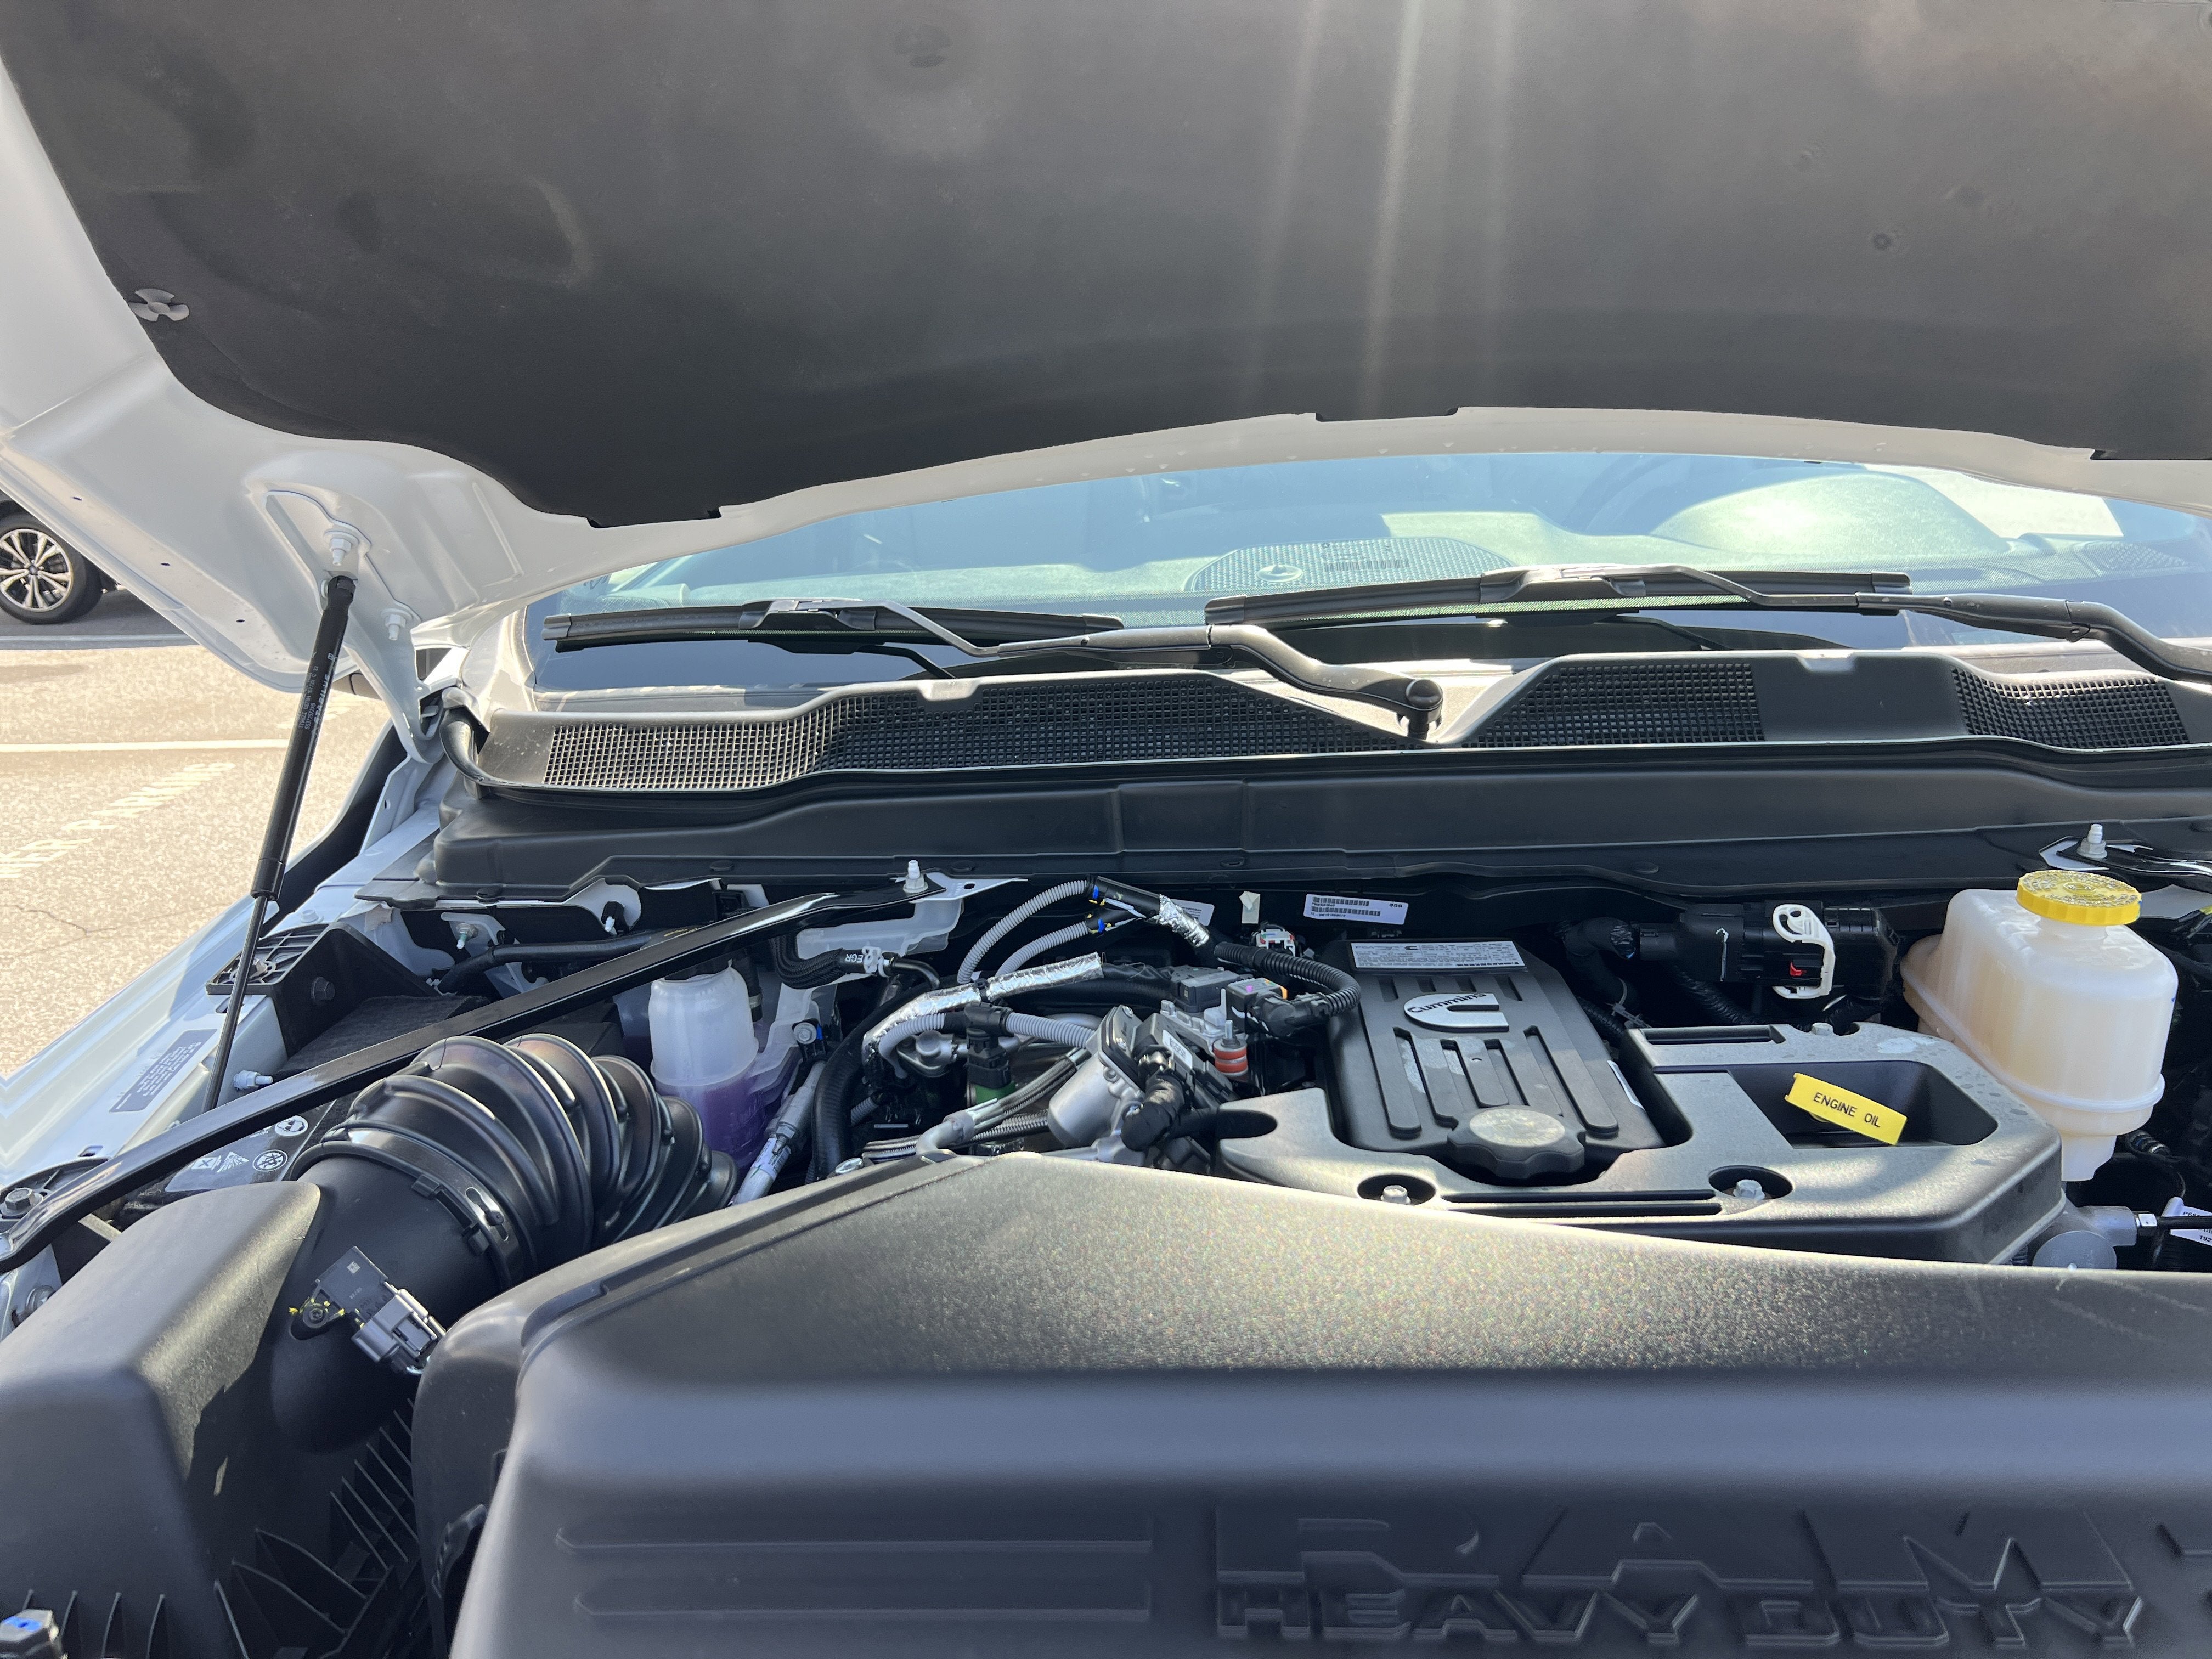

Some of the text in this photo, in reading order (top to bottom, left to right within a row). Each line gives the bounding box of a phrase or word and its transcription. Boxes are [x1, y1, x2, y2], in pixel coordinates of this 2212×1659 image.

[845, 953, 864, 963] EGR
[1407, 992, 1487, 1013] Cummins
[1813, 1092, 1881, 1127] ENGINE OIL
[1216, 1502, 2132, 1590] RAM
[1216, 1587, 2144, 1647] HEAVY DUTY
